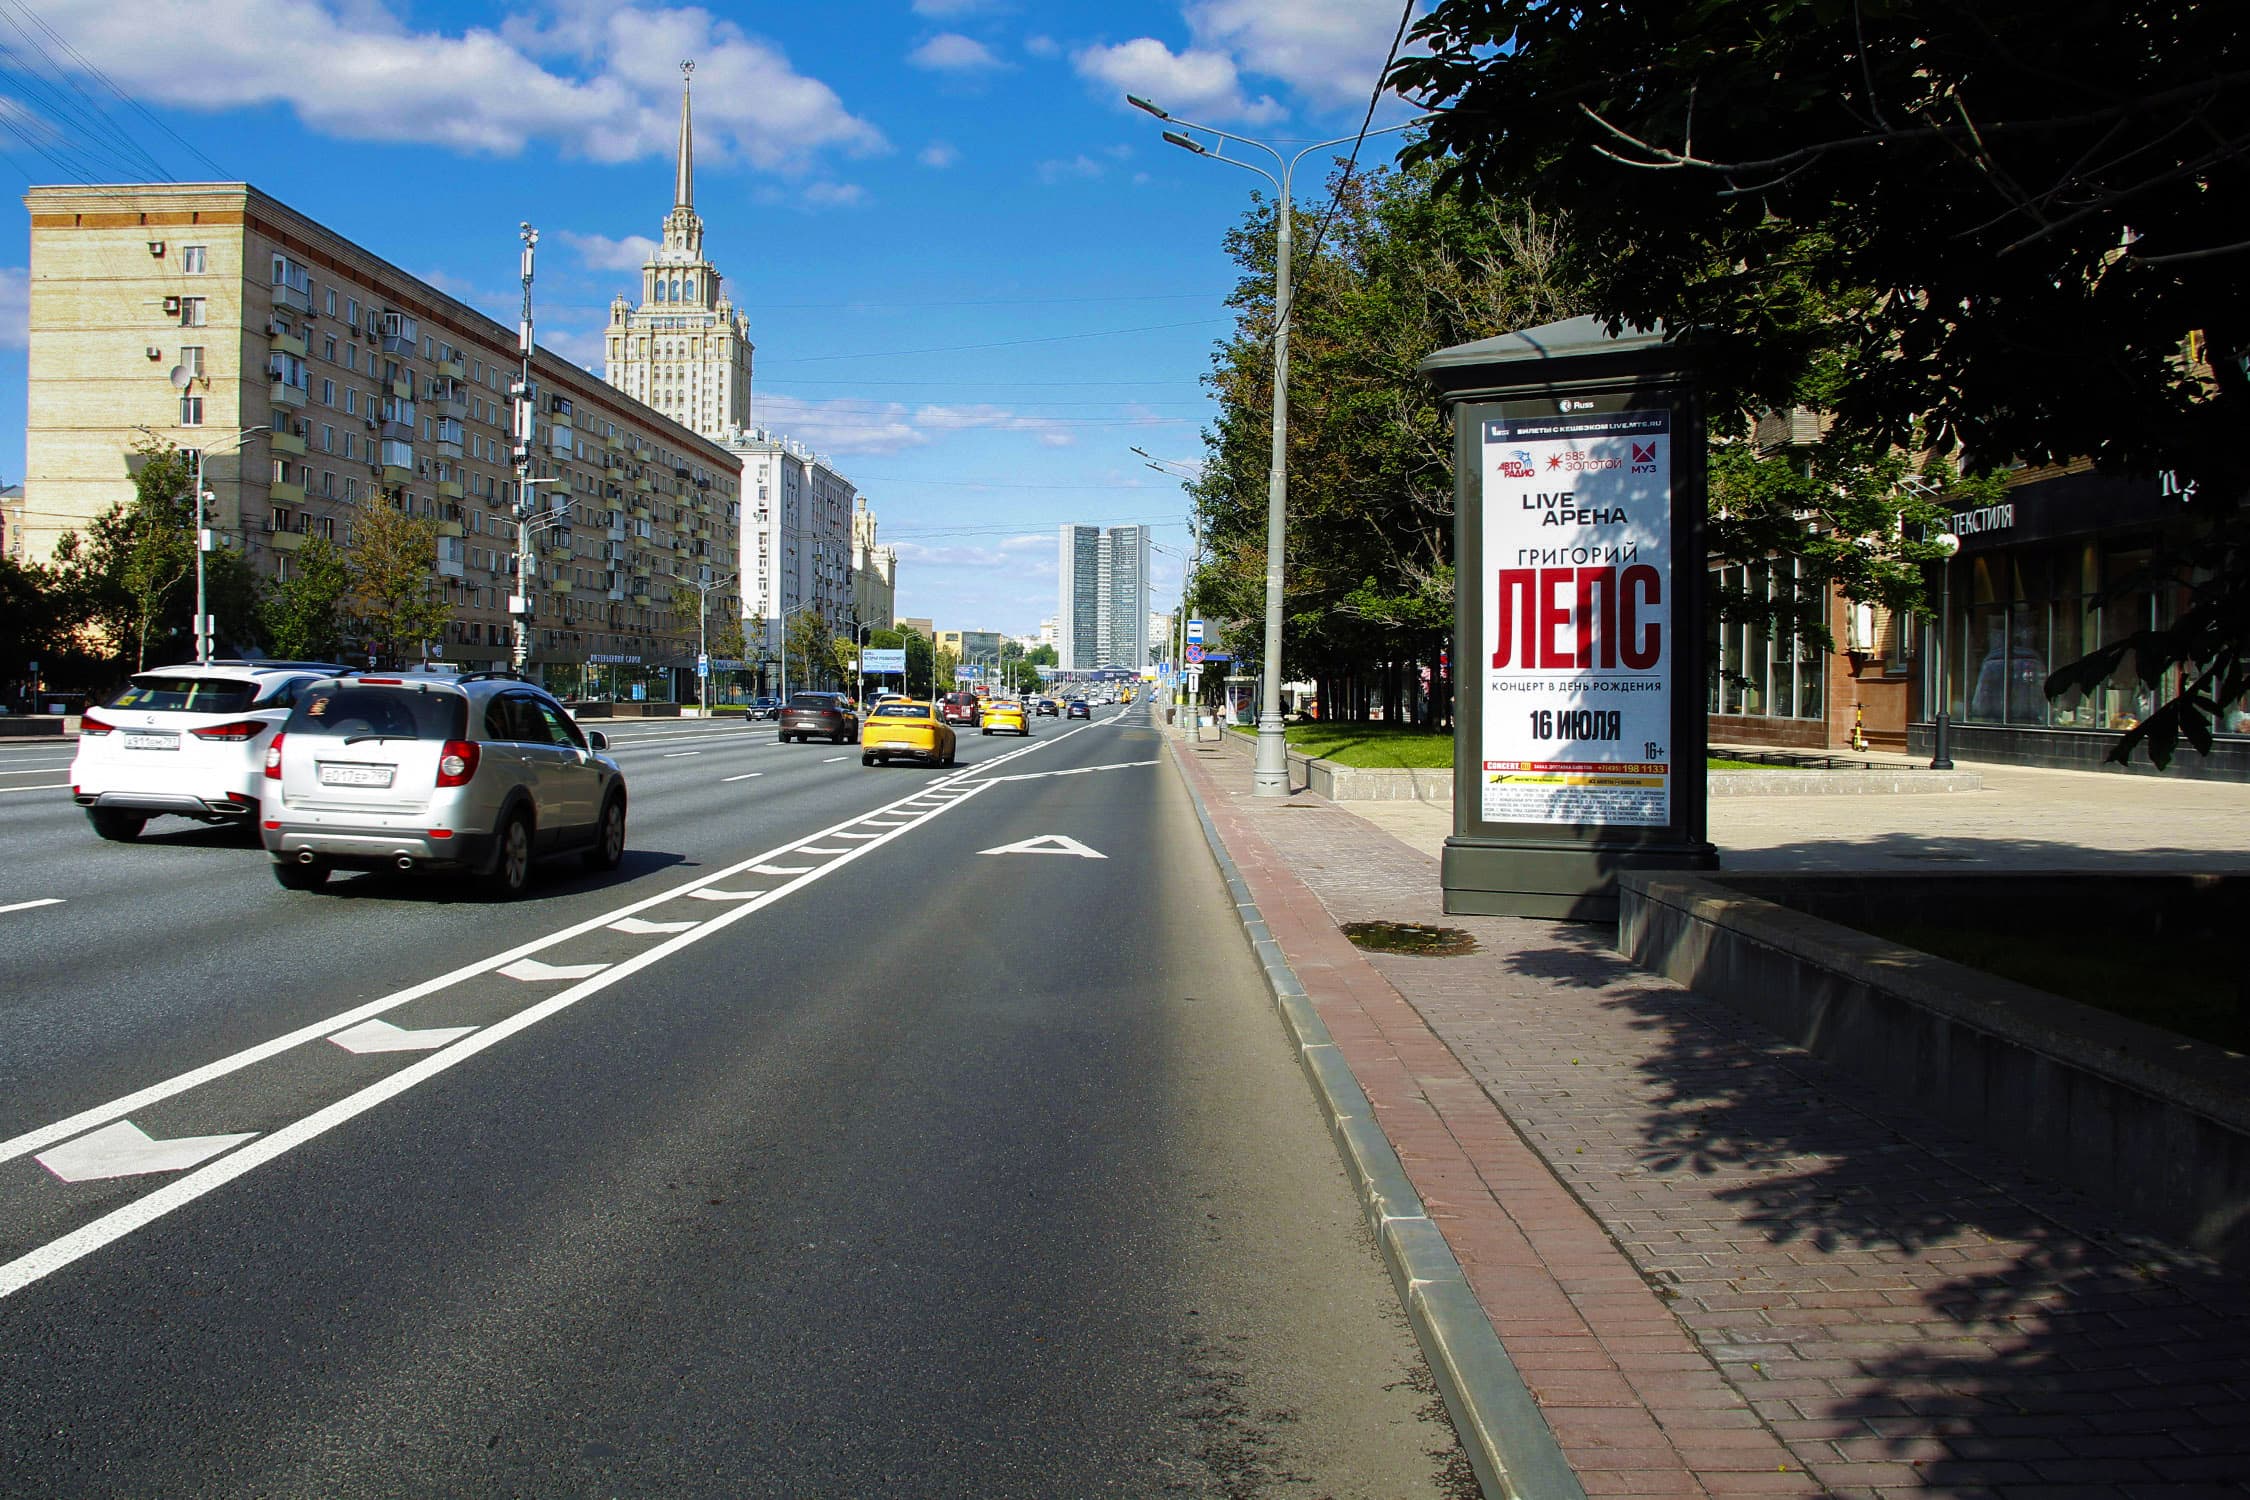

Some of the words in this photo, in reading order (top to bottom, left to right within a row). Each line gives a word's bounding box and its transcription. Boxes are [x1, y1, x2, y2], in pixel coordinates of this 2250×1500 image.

[1565, 452, 1585, 461] 585
[1565, 457, 1622, 471] ЗОЛОТОЙ
[1504, 469, 1535, 478] РАДИО
[1631, 464, 1657, 474] МУЗ
[1522, 492, 1575, 510] LIVE
[1542, 508, 1628, 526] АРЕНА
[1952, 503, 2013, 535] ТЕКСТИЛЯ
[1518, 541, 1637, 566] ГРИГОРИЙ
[1492, 564, 1661, 670] ЛЕПС
[1492, 682, 1544, 692] КОНЦЕРТ
[1549, 682, 1555, 691] В
[1558, 682, 1589, 692] ДЕНЬ
[1593, 682, 1661, 692] РОЖДЕНИЯ
[1530, 710, 1552, 740] 16
[1557, 710, 1621, 740] ИЮЛЯ
[1644, 742, 1665, 760] 16+
[1622, 765, 1639, 773] 198
[1642, 765, 1665, 773] 1133
